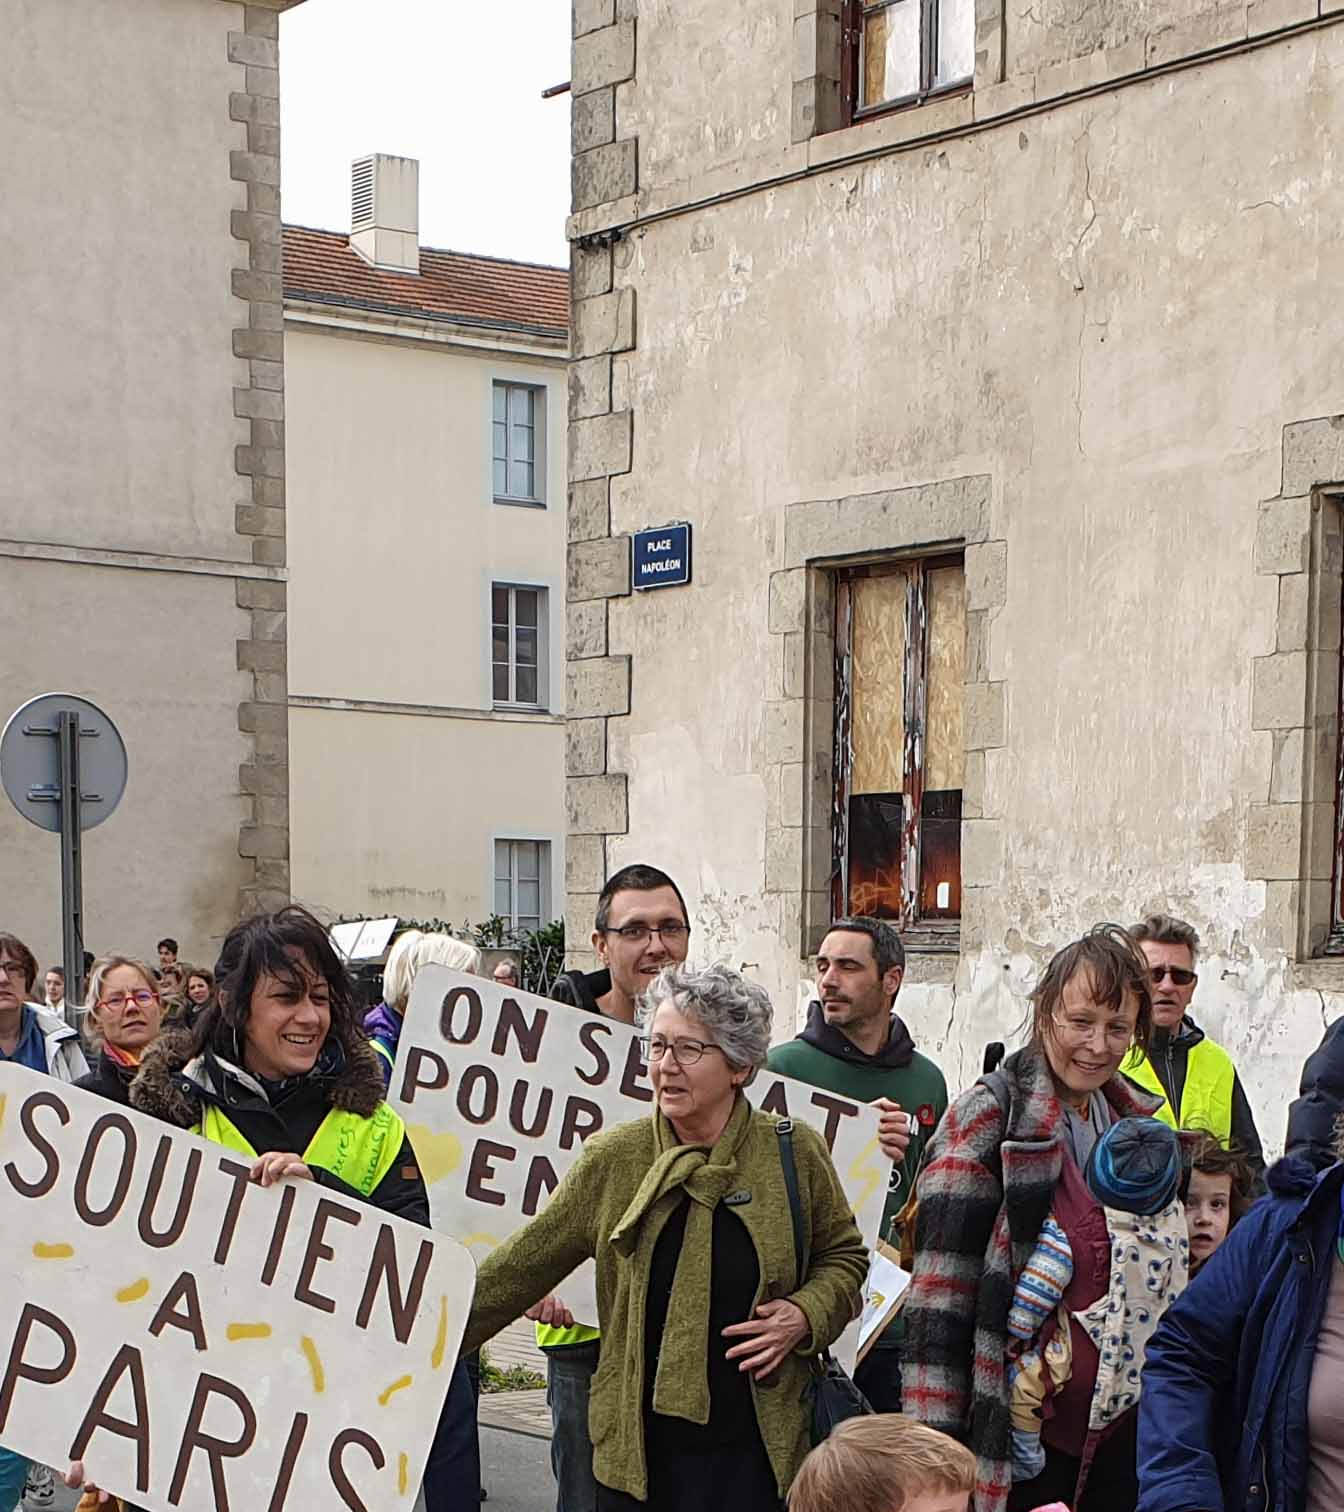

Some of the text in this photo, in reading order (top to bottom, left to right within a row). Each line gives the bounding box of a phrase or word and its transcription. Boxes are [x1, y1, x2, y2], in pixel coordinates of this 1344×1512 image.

[641, 558, 681, 575] NAPOLÉON
[647, 539, 672, 553] PLACE
[399, 1046, 604, 1151] POUR
[440, 986, 548, 1063] ON
[574, 1021, 653, 1102] SE
[760, 1081, 859, 1153] AT
[4, 1092, 434, 1344] SOUTIEN
[148, 1271, 208, 1351] A
